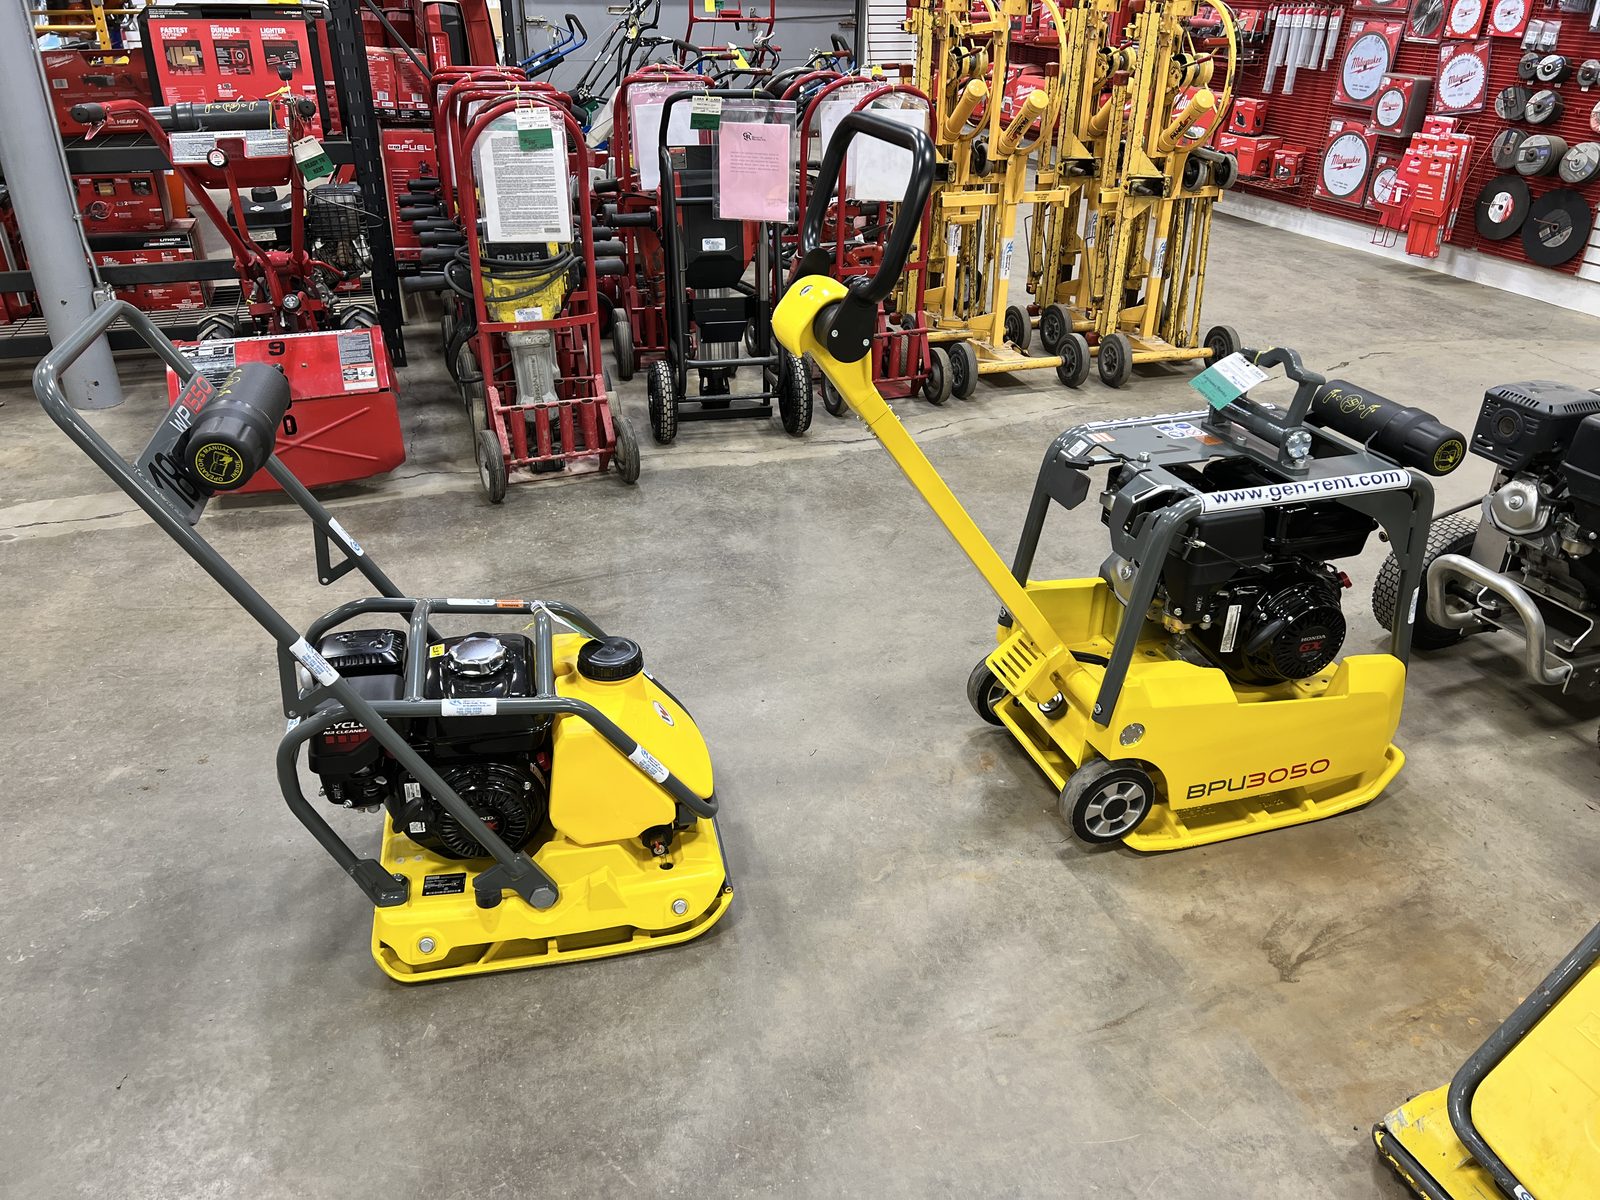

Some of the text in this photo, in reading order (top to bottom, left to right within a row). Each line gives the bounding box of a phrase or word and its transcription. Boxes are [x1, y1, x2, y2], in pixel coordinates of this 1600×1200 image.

[160, 26, 189, 34] FASTEST
[210, 26, 241, 34] DURABLE
[1351, 55, 1383, 70] Milwaukee
[1448, 70, 1477, 86] Milwaukee
[1330, 154, 1362, 166] Milwaukee
[168, 375, 214, 434] WP1550
[198, 445, 241, 482] OPERATOR'S MANUAL INSIDE
[1210, 470, 1401, 505] www.gen-rent.com
[1301, 634, 1327, 642] HONDA
[1298, 641, 1323, 653] GX
[1186, 758, 1331, 800] BPU3050
